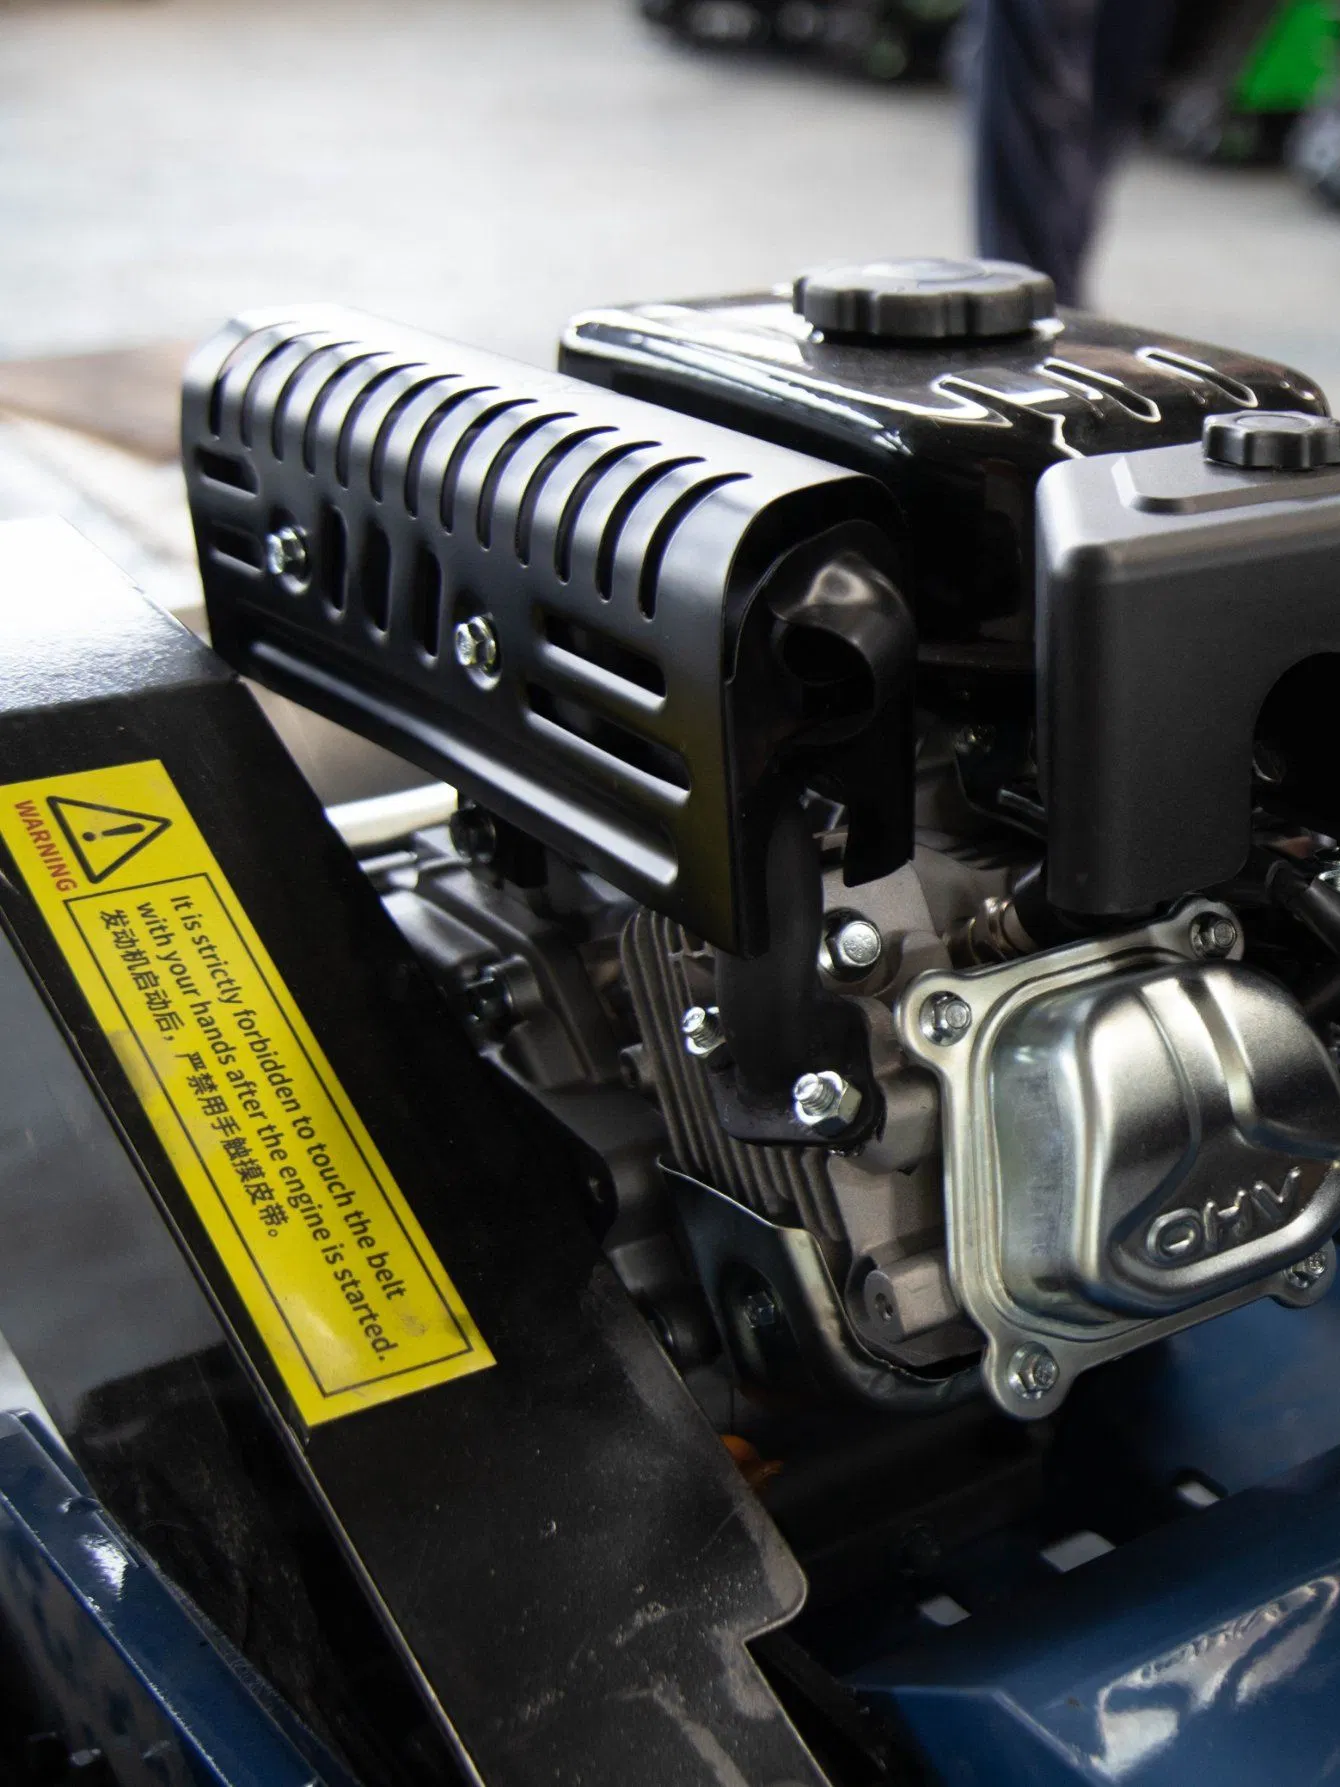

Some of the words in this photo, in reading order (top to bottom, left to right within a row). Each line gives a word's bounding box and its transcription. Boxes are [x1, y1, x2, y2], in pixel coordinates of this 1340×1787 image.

[15, 800, 77, 892] WARNING
[170, 895, 193, 911] It
[180, 914, 202, 931] is
[191, 935, 243, 1004] strictly
[100, 909, 288, 1237] 发动机启动后，严禁用手触摸皮带。
[233, 1009, 301, 1113] forbidden
[136, 902, 175, 947] with
[156, 950, 200, 996] your
[189, 1001, 237, 1065] hands
[226, 1069, 267, 1120] after
[256, 1124, 288, 1161] the
[279, 1166, 331, 1241] engine
[321, 1243, 344, 1265] is
[333, 1268, 398, 1361] started.
[292, 1115, 315, 1140] to
[307, 1143, 356, 1208] touch
[343, 1210, 376, 1249] the
[1147, 1166, 1301, 1263] OHV
[366, 1251, 406, 1300] belt
